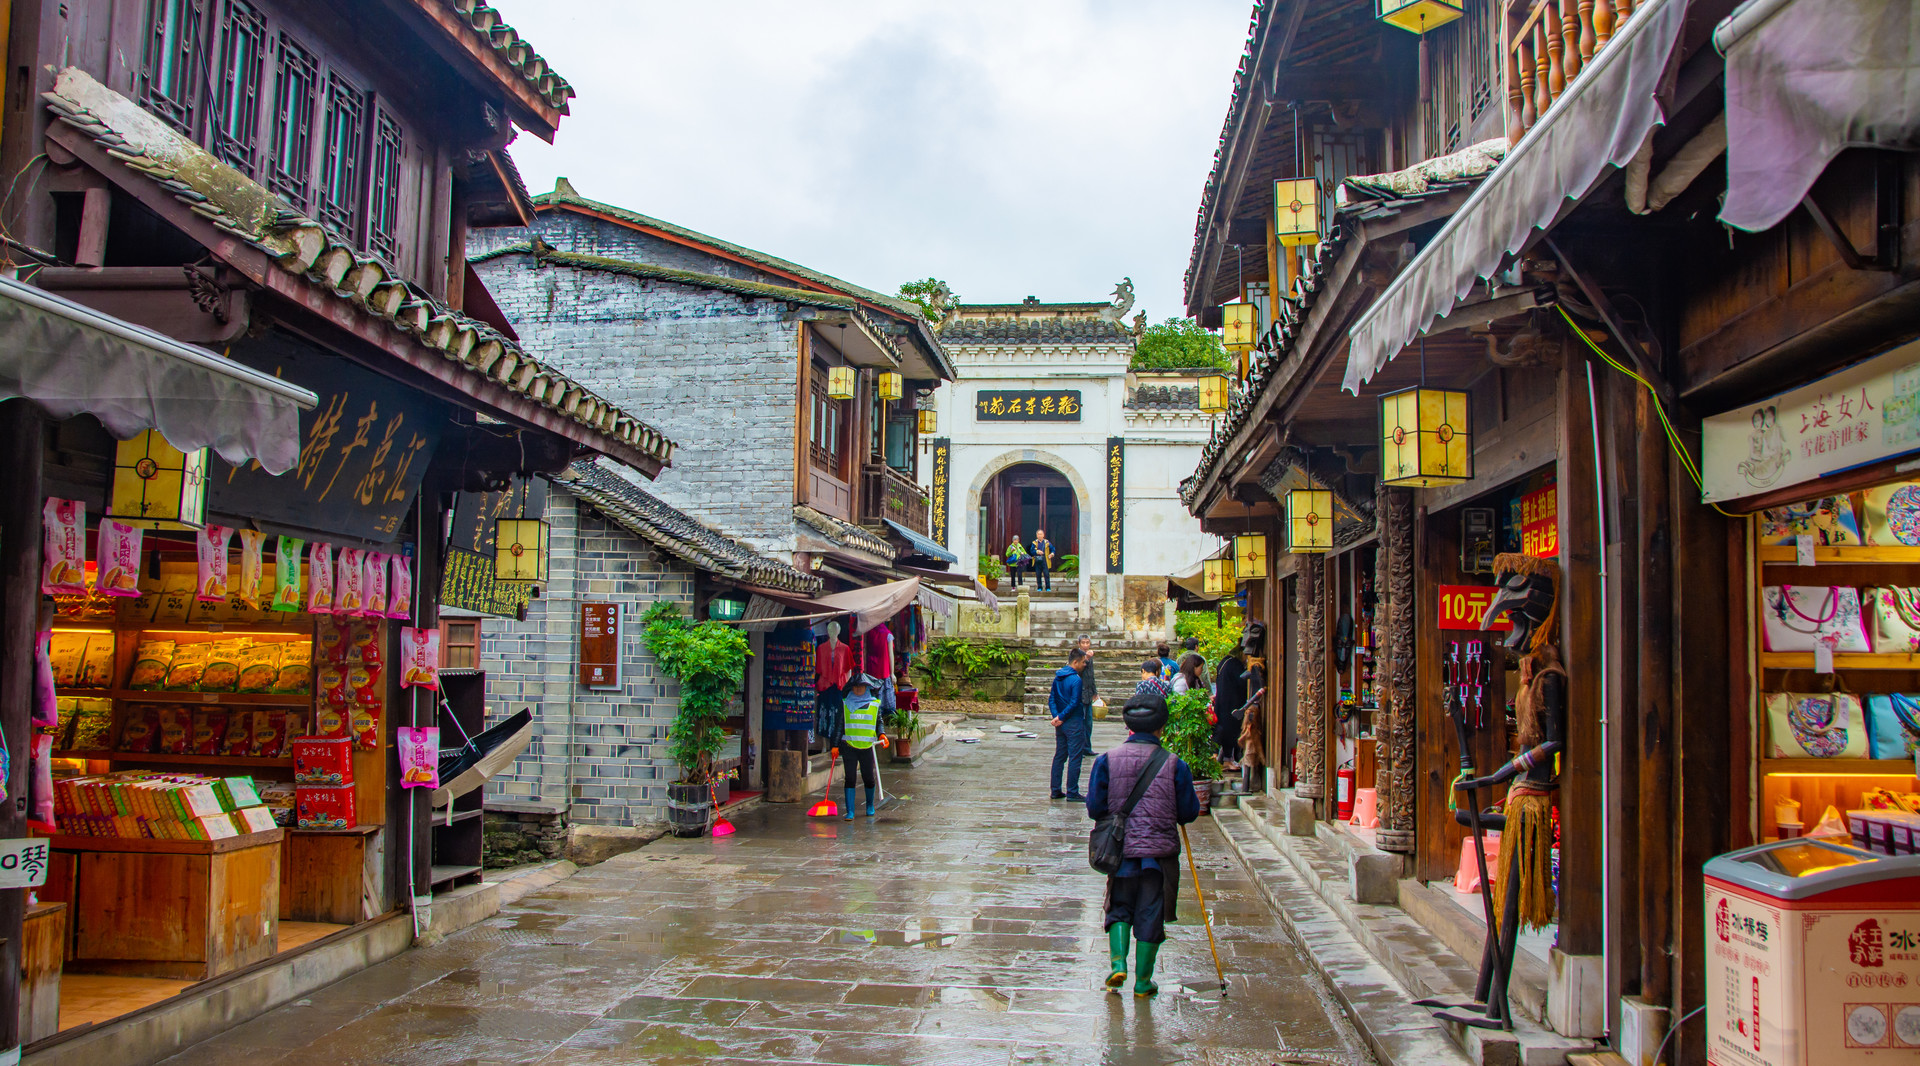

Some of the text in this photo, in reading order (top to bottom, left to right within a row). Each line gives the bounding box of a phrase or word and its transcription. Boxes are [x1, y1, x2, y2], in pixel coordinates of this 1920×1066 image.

[1800, 387, 1874, 434] 上海女人
[374, 515, 399, 534] 二店
[1522, 488, 1556, 527] 禁止拍照
[1523, 522, 1557, 556] 同行止步
[1889, 929, 1920, 951] 冰
